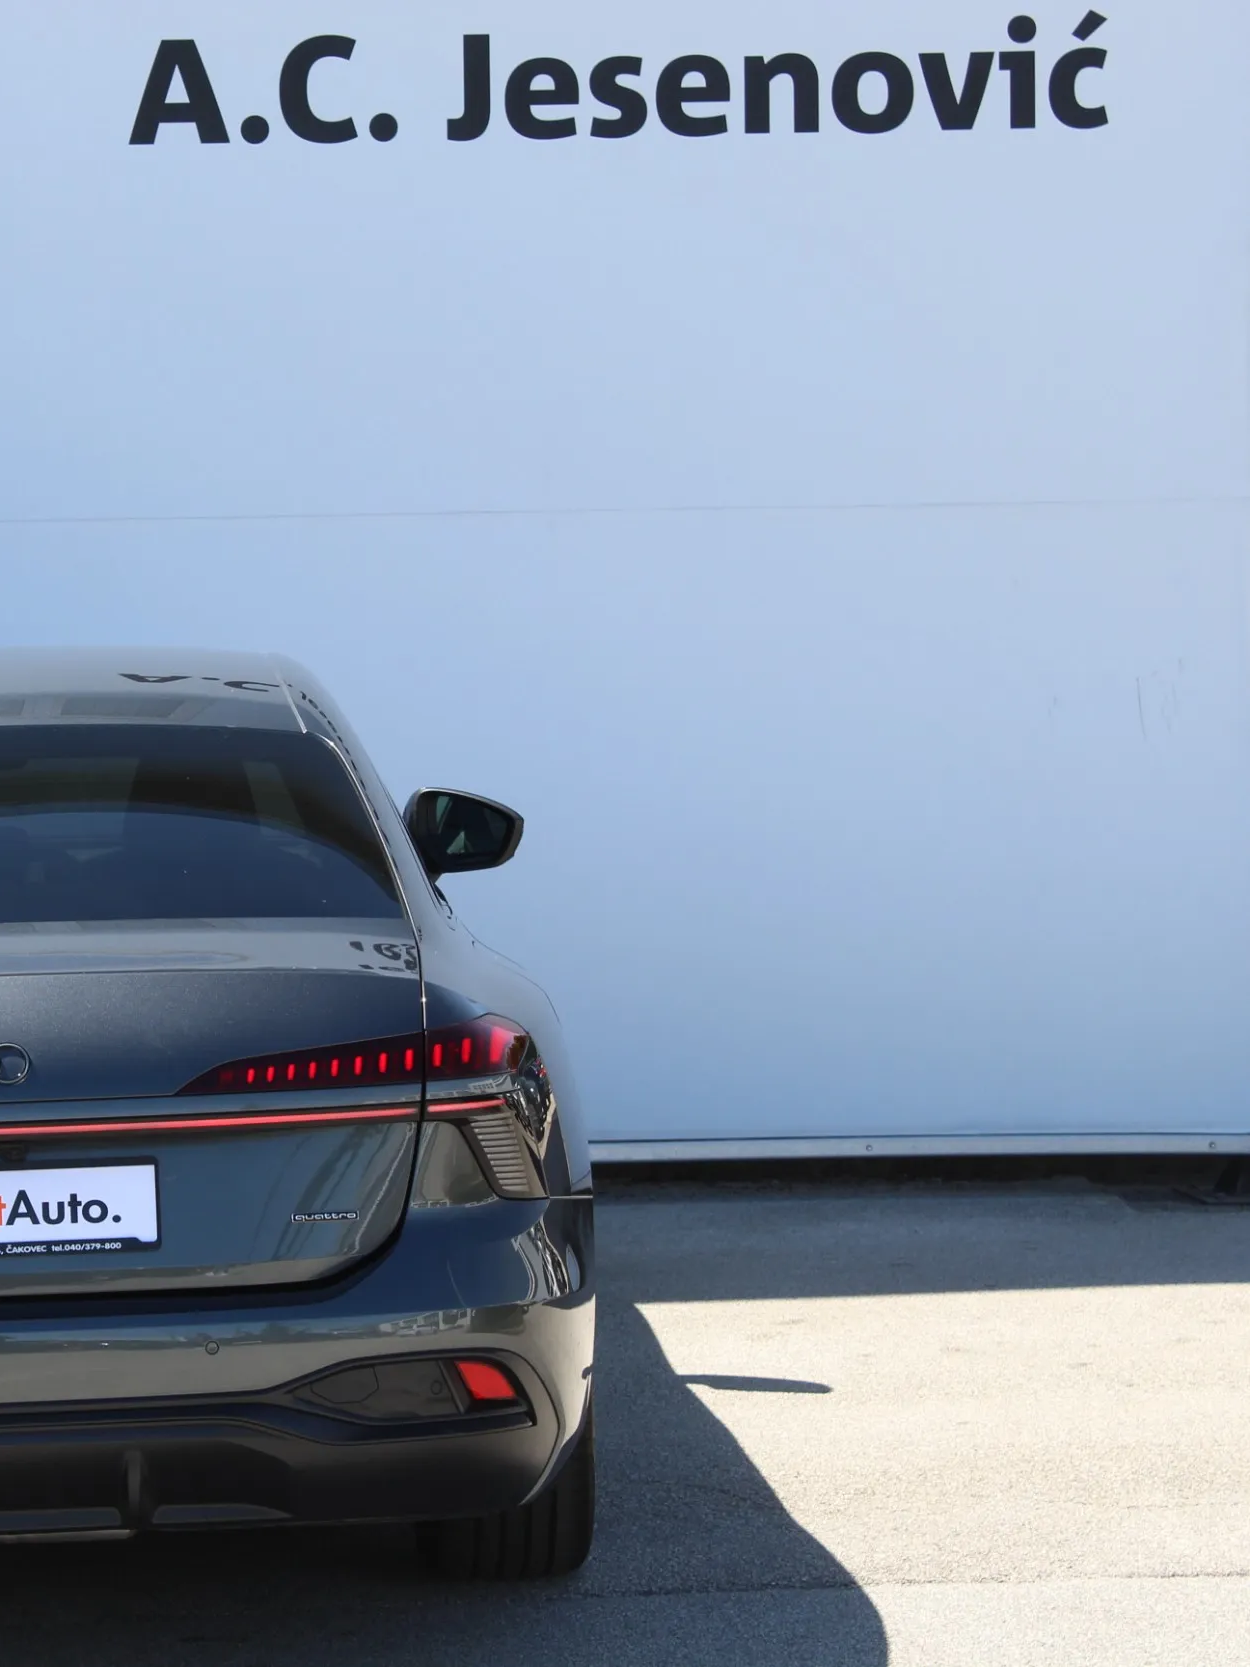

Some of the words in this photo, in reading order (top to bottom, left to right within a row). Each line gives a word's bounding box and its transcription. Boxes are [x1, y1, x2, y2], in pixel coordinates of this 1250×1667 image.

[128, 34, 399, 145] A.C.
[446, 9, 1109, 142] Jesenović
[294, 1212, 357, 1222] quattro
[6, 1244, 47, 1254] ČAKOVEC
[51, 1242, 122, 1252] tel.040/379-800
